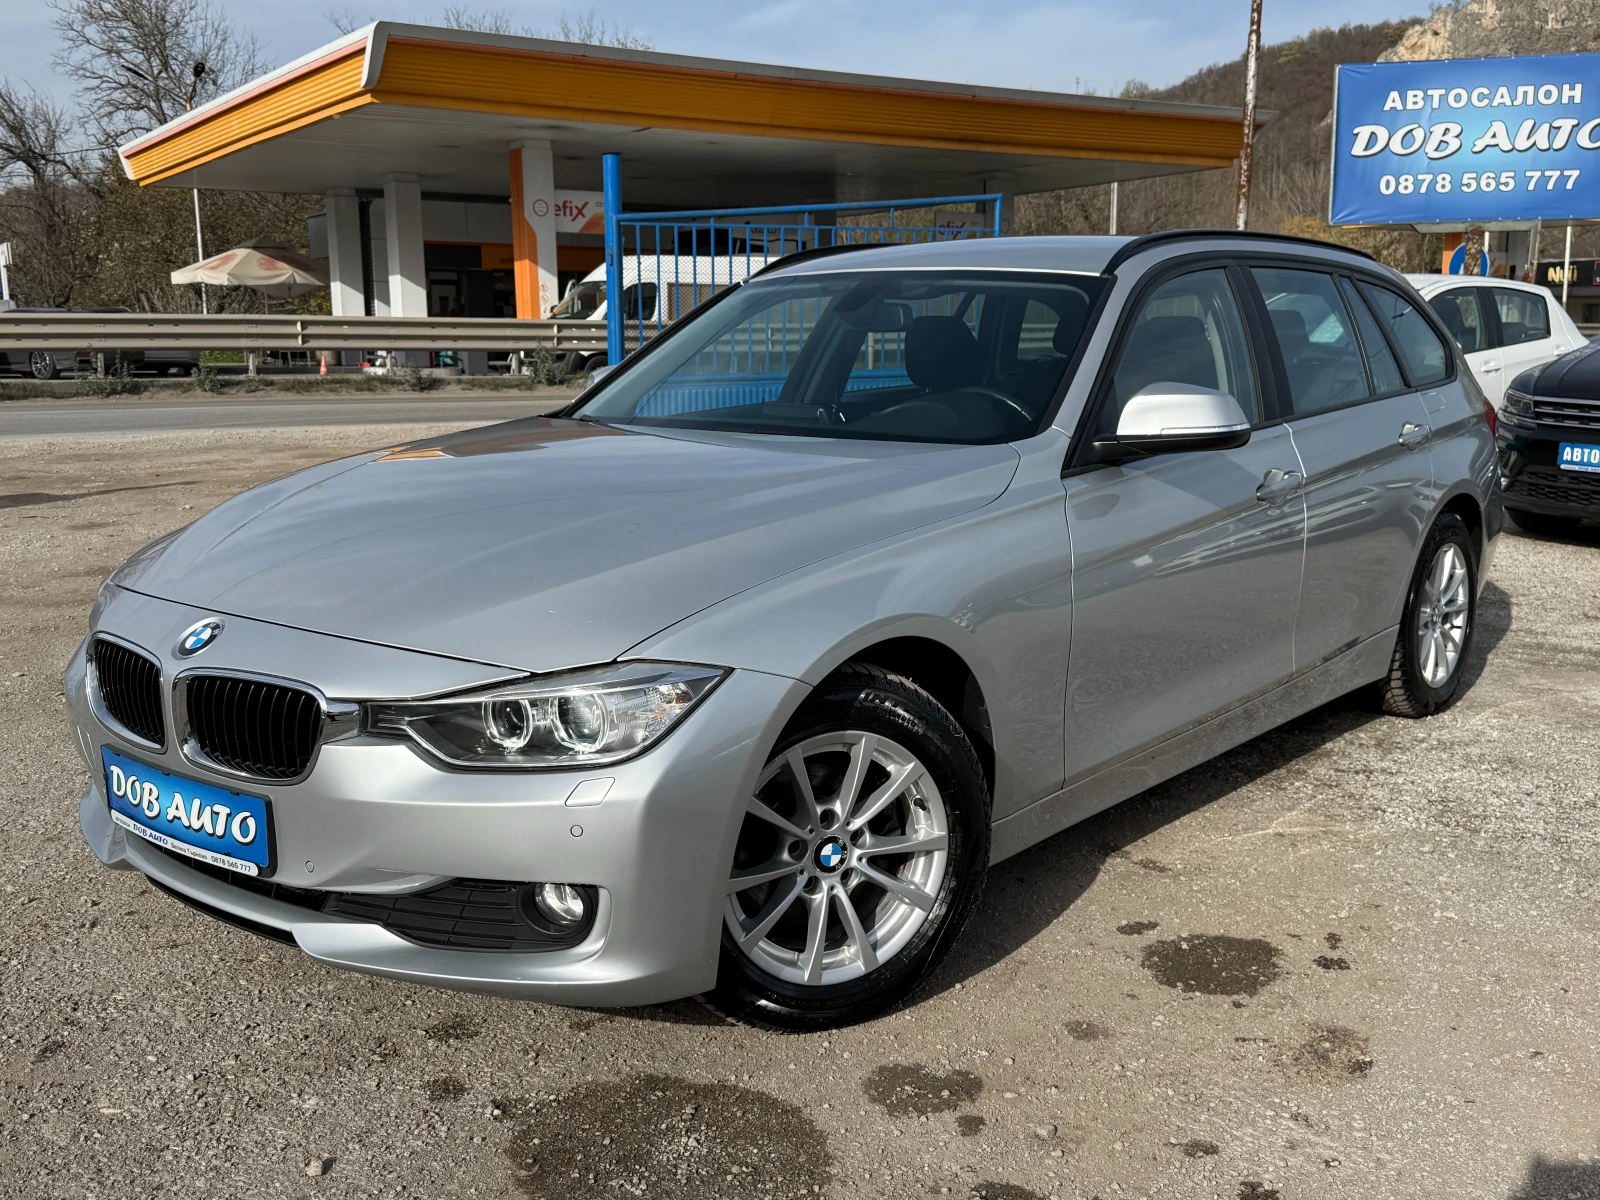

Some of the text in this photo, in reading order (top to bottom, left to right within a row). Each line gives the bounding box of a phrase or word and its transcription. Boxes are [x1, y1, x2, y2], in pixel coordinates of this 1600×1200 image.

[1383, 83, 1583, 111] АВТОСАЛОН
[1350, 117, 1600, 159] DOB AUTO
[1379, 169, 1581, 195] 0878 565 777
[1563, 446, 1600, 464] АВТО
[110, 765, 257, 844] DOB AUTO
[133, 823, 169, 845] DOB AUTO
[210, 855, 226, 866] 0878
[239, 863, 252, 873] 777
